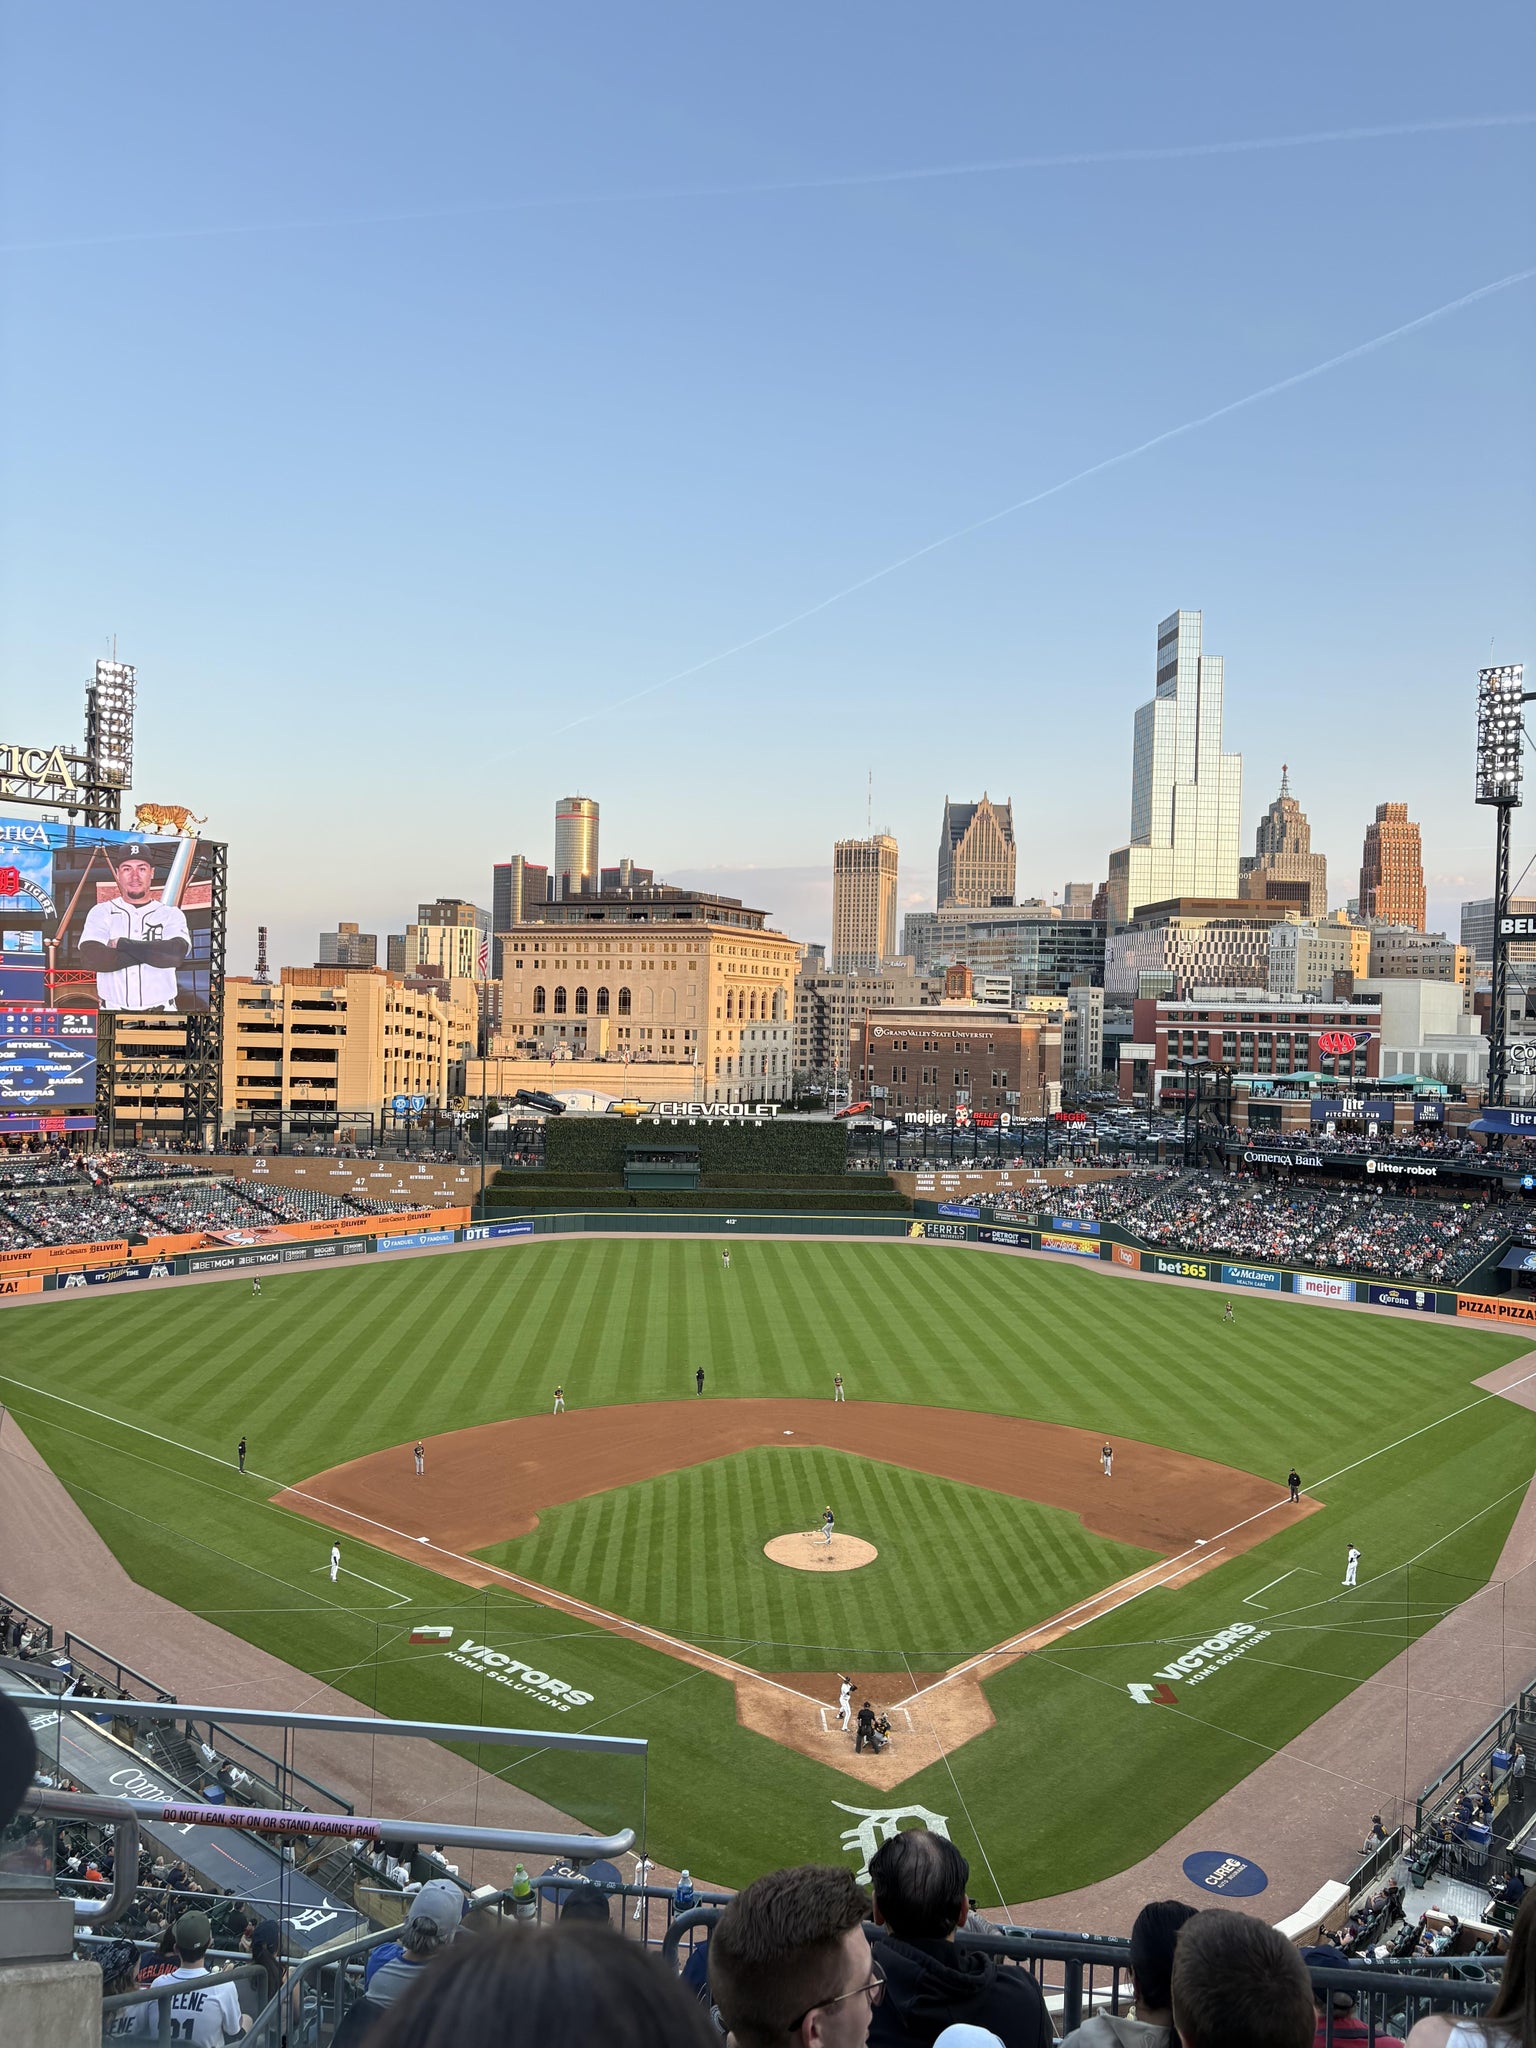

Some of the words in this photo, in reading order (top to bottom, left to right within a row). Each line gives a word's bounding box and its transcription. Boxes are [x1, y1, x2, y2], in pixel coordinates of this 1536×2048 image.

[23, 881, 54, 914] TIGERS
[1500, 918, 1536, 934] BEL
[63, 1014, 88, 1025] 2-1
[908, 1029, 931, 1037] VALLEY
[931, 1030, 951, 1038] STATE
[951, 1030, 994, 1039] UNIVERSITY
[1323, 1033, 1353, 1053] AAA
[659, 1103, 782, 1116] CHEVROLET
[1342, 1098, 1365, 1112] Lite
[635, 1119, 762, 1127] FOUNTAIN
[904, 1109, 948, 1126] meijer
[975, 1119, 995, 1127] TIRE
[1055, 1112, 1086, 1121] FIEGER
[1510, 1112, 1532, 1126] Lite
[1066, 1121, 1087, 1130] LAW
[255, 1159, 267, 1167] 23
[338, 1161, 344, 1169] 5
[378, 1163, 384, 1171] 2
[1295, 1155, 1323, 1167] Bank
[418, 1165, 426, 1173] 16
[460, 1168, 465, 1176] 6
[1033, 1170, 1041, 1178] 11
[1064, 1170, 1074, 1178] 42
[1000, 1172, 1009, 1180] 10
[466, 1228, 490, 1241] DTE
[927, 1223, 965, 1235] FERRIS
[991, 1231, 1019, 1240] DETROIT
[391, 1239, 414, 1247] FANDUEL
[427, 1235, 450, 1243] FANDUEL
[50, 1249, 66, 1257] Little
[90, 1243, 123, 1253] DELIVERY
[1120, 1248, 1132, 1264] hop
[200, 1258, 235, 1269] BETMGM
[245, 1253, 279, 1264] BETMGM
[104, 1268, 130, 1282] Miller
[1158, 1259, 1207, 1278] bet365
[1240, 1268, 1275, 1282] McLaren
[1305, 1280, 1342, 1296] meijer
[1379, 1293, 1409, 1305] Corona
[1458, 1300, 1496, 1314] PIZZA!
[1153, 1622, 1257, 1680] VICTORS
[1185, 1664, 1219, 1685] HOME
[1216, 1630, 1272, 1666] SOLUTIONS
[457, 1639, 595, 1706] VICTORS
[443, 1651, 488, 1673] HOME
[486, 1670, 572, 1712] SOLUTIONS
[163, 1808, 176, 1819] DO
[179, 1810, 199, 1821] NOT
[201, 1812, 227, 1825] LEAN,
[229, 1814, 245, 1824] SIT
[247, 1815, 261, 1827] ON
[263, 1817, 276, 1828] OR
[279, 1818, 310, 1831] STAND
[312, 1821, 354, 1836] AGAINST
[356, 1825, 378, 1838] RAIL
